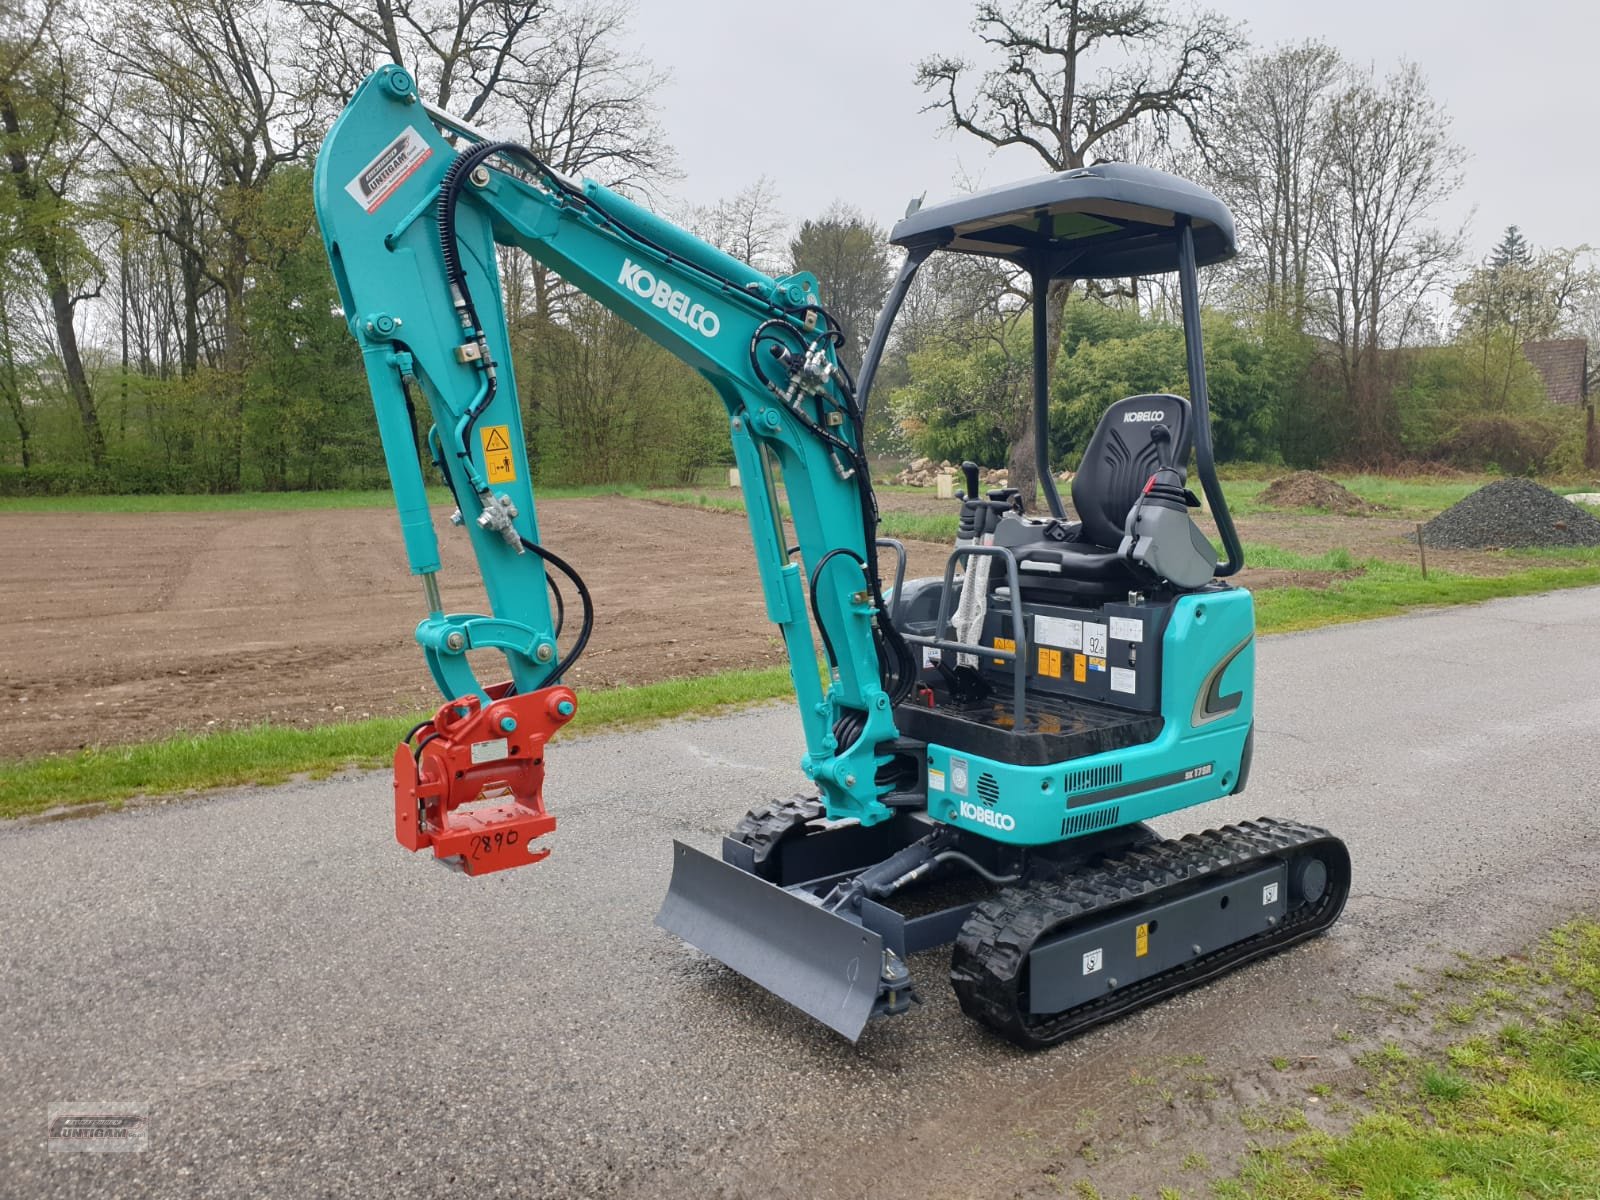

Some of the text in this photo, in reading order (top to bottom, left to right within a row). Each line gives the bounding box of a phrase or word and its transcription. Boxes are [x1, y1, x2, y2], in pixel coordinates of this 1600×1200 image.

[617, 257, 720, 338] KOBELCO
[1123, 410, 1165, 423] KOBELCO
[1089, 637, 1099, 654] 92
[960, 800, 1016, 831] KOBELCO
